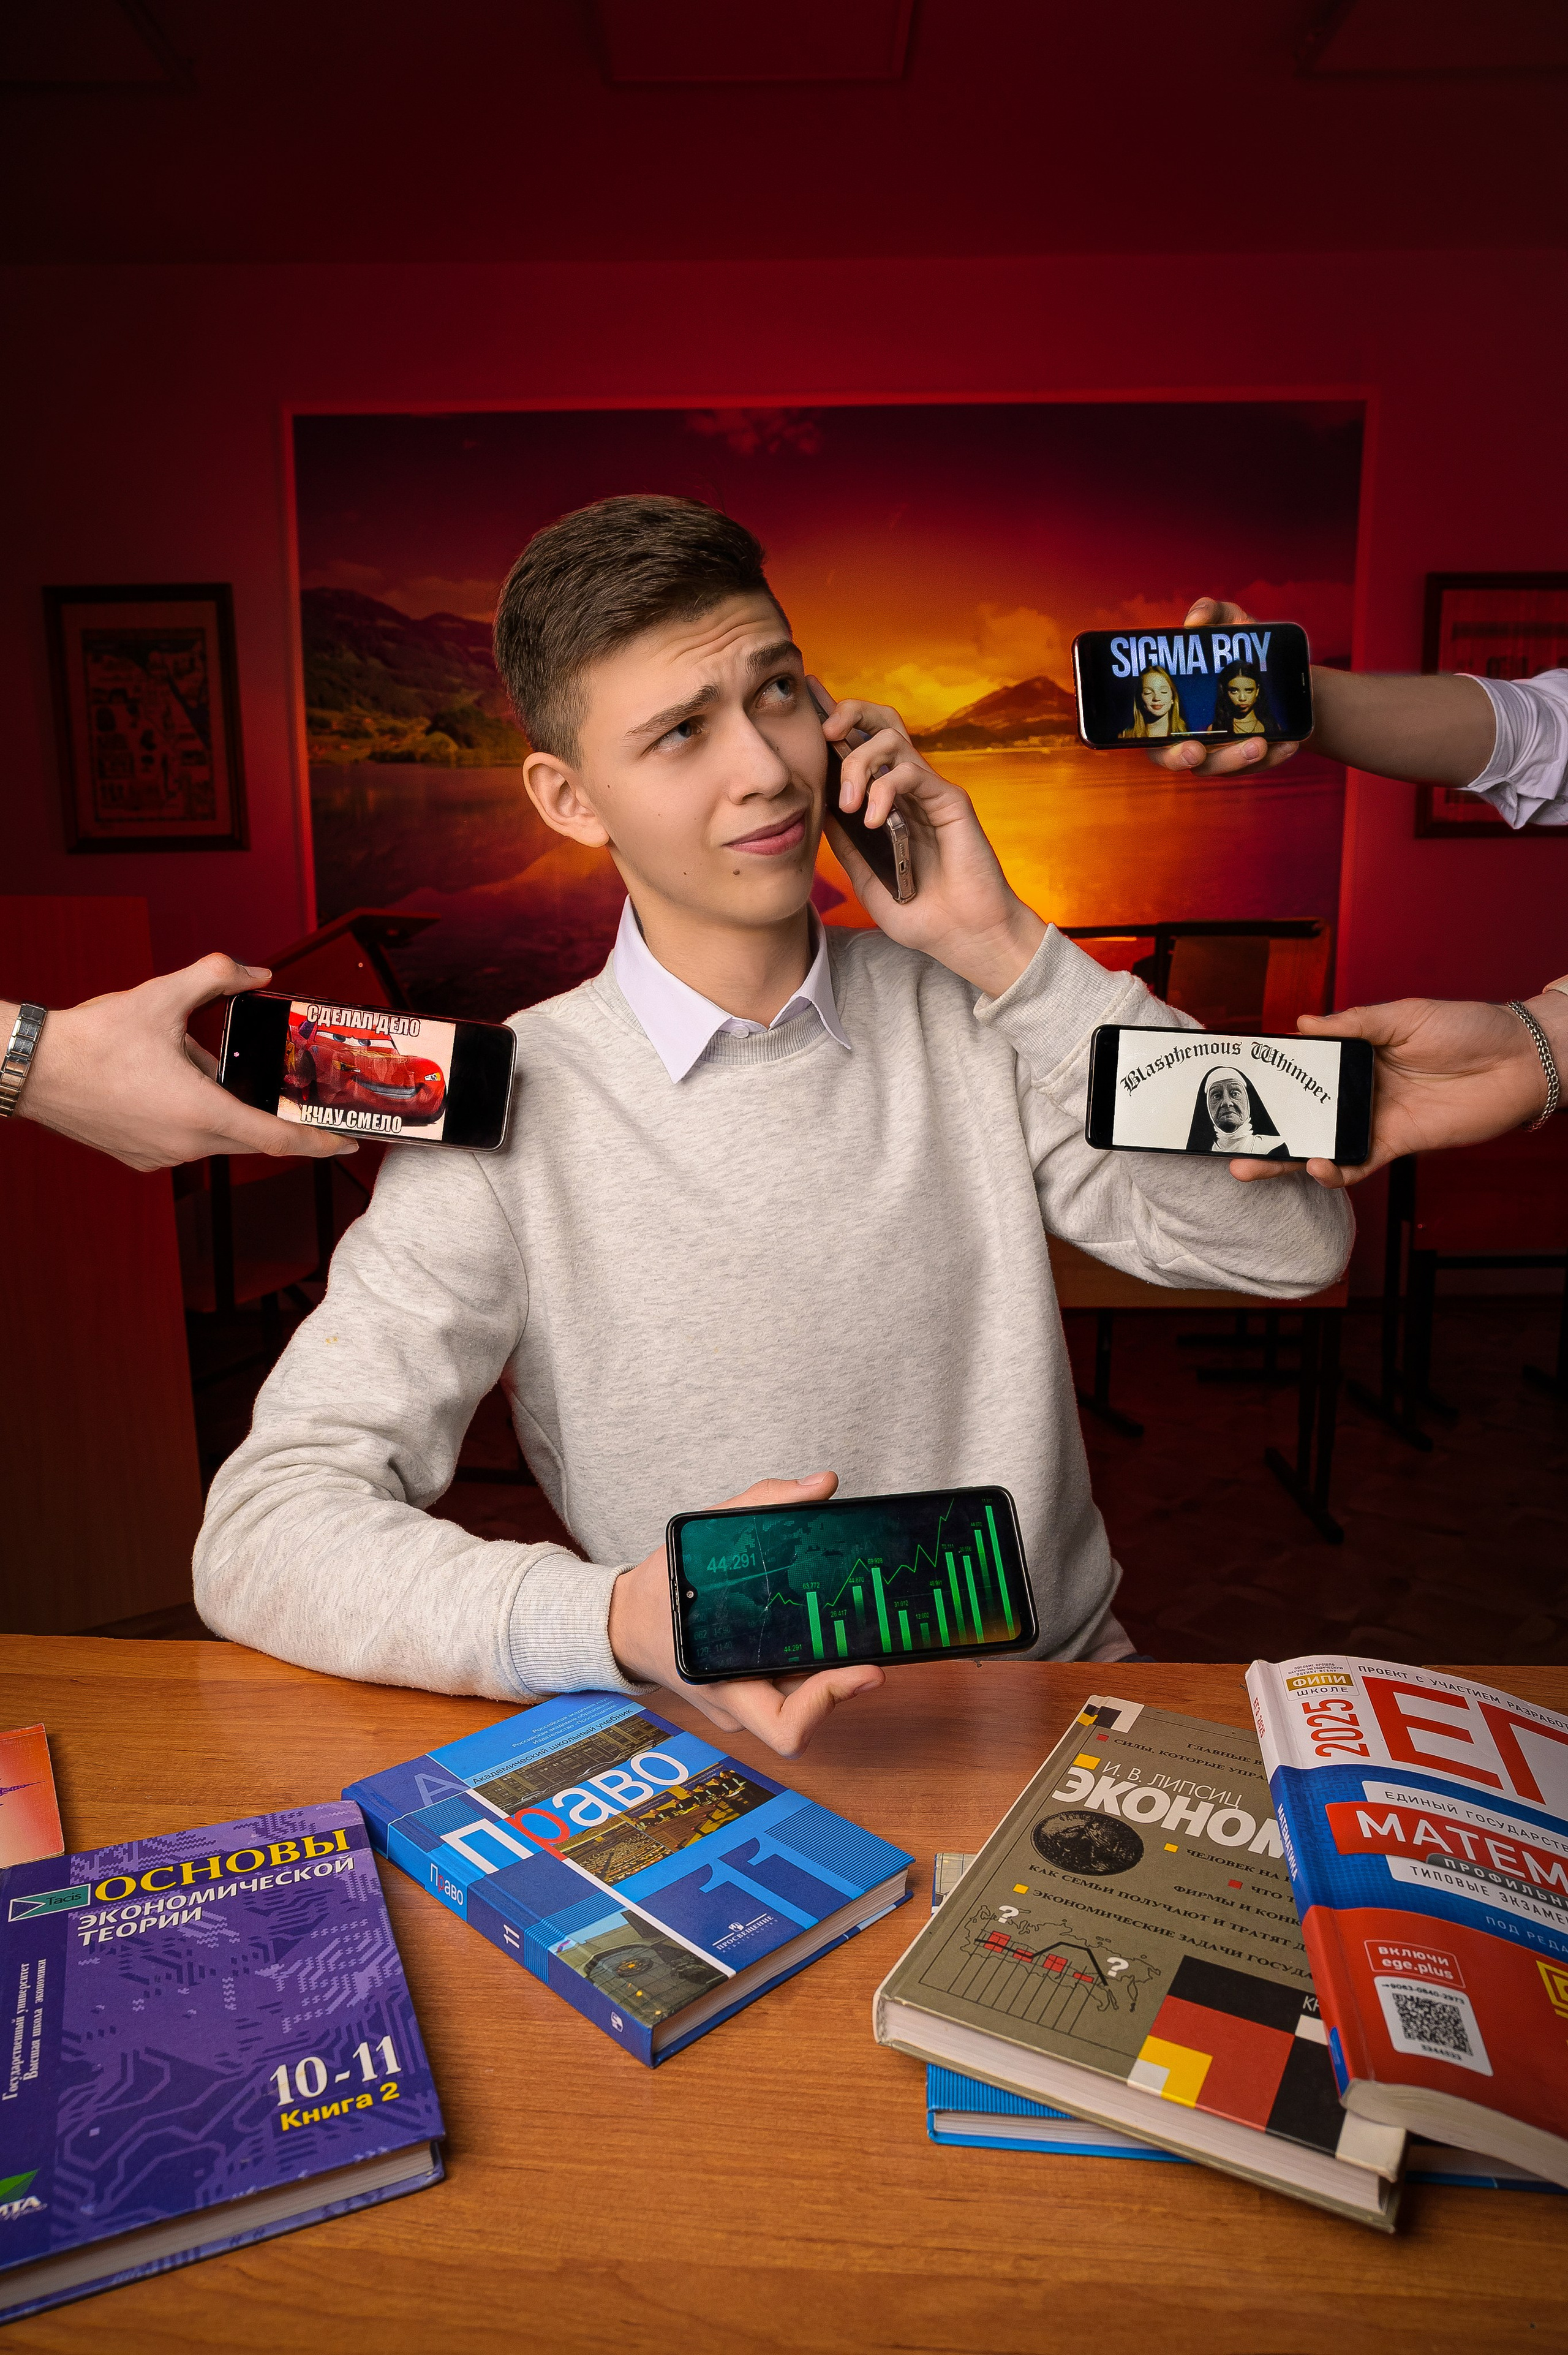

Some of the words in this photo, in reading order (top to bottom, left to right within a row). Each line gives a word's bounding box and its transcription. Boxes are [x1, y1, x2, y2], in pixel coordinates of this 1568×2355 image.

[1110, 633, 1208, 678] SIGMA
[1211, 632, 1272, 674] BOY
[307, 1004, 374, 1030] СДЕЛАЛ
[375, 1017, 421, 1037] ДЕЛО
[1120, 1041, 1243, 1097] Blasphemous
[1251, 1041, 1331, 1104] Whimper
[300, 1105, 344, 1126] КЧАУ
[346, 1111, 402, 1133] СМЕЛО
[707, 1553, 756, 1573] 44.291
[830, 1609, 847, 1618] 26.417
[783, 1644, 802, 1653] 44.291
[1292, 1675, 1347, 1687] ФИПИ
[1297, 1687, 1349, 1696] ШКОЛЕ
[1358, 1665, 1408, 1679] ПРОЕКТ
[1430, 1679, 1501, 1704] УЧАСТИЕМ
[472, 1748, 549, 1785] Академический
[549, 1725, 597, 1751] школьный
[596, 1709, 633, 1730] учебник
[1302, 1699, 1370, 1758] 2025
[1159, 1750, 1226, 1771] КОТОРЫЕ
[1229, 1767, 1268, 1782] УПРА
[1187, 1743, 1251, 1763] ГЛАВНЫЕ
[1102, 1761, 1120, 1777] И.
[1127, 1767, 1142, 1783] В.
[1147, 1773, 1242, 1809] ЛИПСИЦ
[1385, 1791, 1458, 1815] ЕДИНЫЙ
[439, 1752, 689, 1875] Право
[1277, 1803, 1298, 1881] МАТЕМАТИКА
[94, 1829, 350, 1902] ОСНОВЫ
[699, 1837, 865, 1930] 11
[1186, 1848, 1256, 1873] ЧЕЛОВЕК
[1259, 1869, 1280, 1880] НА
[1410, 1865, 1490, 1896] ТИПОВЫЕ
[46, 1892, 82, 1905] Tacis
[77, 1855, 355, 1930] ЭКОНОМИЧЕСКОЙ
[430, 1863, 464, 1905] Право
[1174, 1885, 1235, 1907] ФИРМЫ
[1238, 1903, 1251, 1912] И
[1251, 1886, 1283, 1899] ЧТО
[1444, 1858, 1568, 1910] ПРОФИЛЬН
[1028, 1864, 1059, 1878] КАК
[1061, 1875, 1114, 1894] СЕМЬИ
[1117, 1891, 1210, 1922] ПОЛУЧАЮТ
[1213, 1918, 1226, 1927] И
[1230, 1922, 1292, 1946] ТРАТЯТ
[1033, 1889, 1175, 1938] ЭКОНОМИЧЕСКИЕ
[1179, 1934, 1243, 1959] ЗАДАЧИ
[77, 1907, 203, 1946] ТЕОРИИ
[503, 1924, 520, 1949] 11
[716, 1915, 774, 1951] ПРОСВЕЩЕНИЕ
[1486, 1916, 1520, 1935] ПОД
[35, 1959, 47, 2004] экономики
[1382, 1958, 1453, 1980] ege.plus
[2, 2016, 25, 2101] Государственный
[17, 1963, 31, 2014] университет
[32, 2008, 43, 2037] школа
[23, 2039, 41, 2081] Высшая
[269, 2035, 402, 2107] 10-11
[280, 2091, 374, 2131] Книга
[379, 2082, 400, 2103] 2
